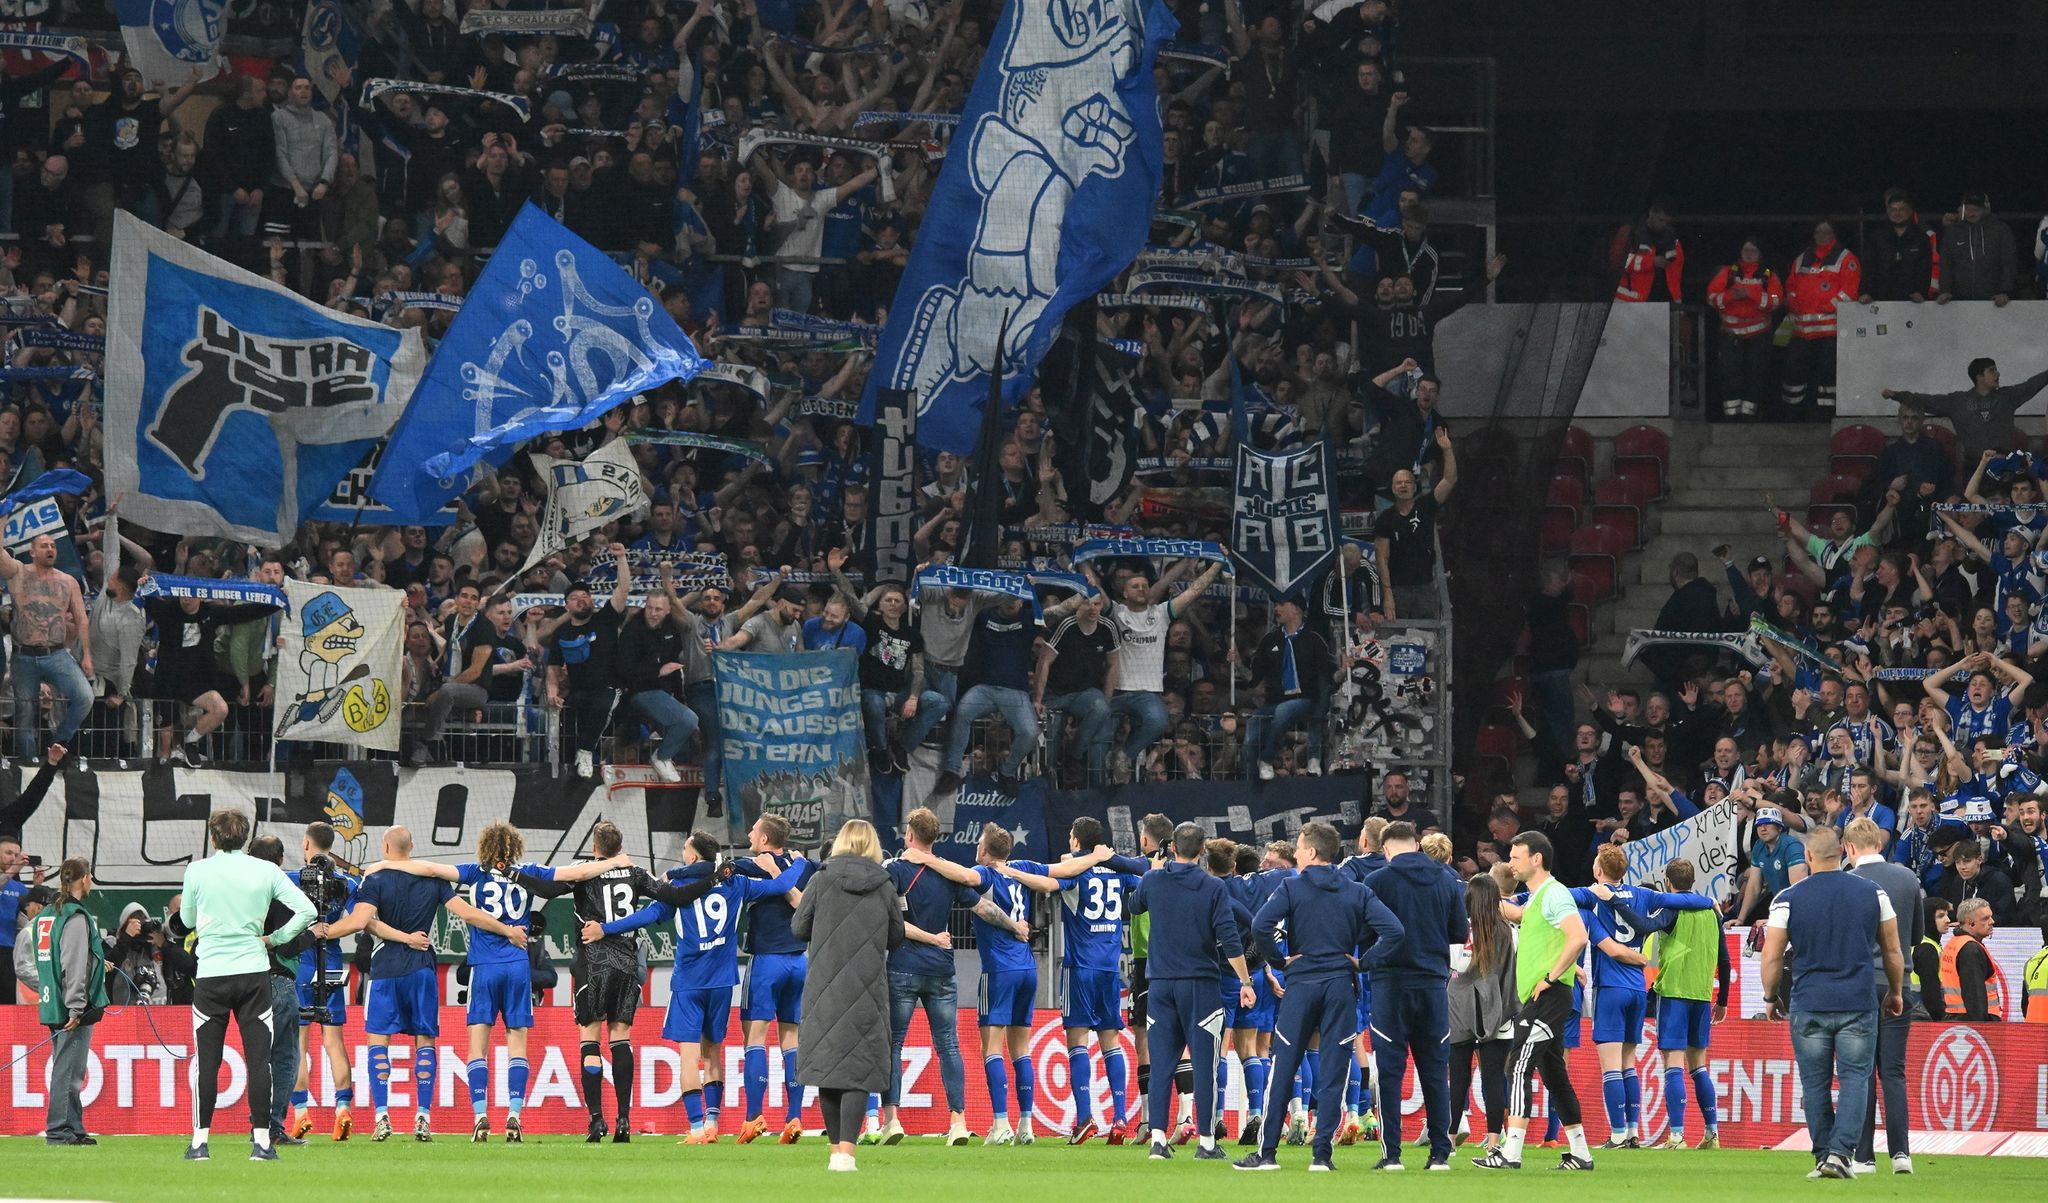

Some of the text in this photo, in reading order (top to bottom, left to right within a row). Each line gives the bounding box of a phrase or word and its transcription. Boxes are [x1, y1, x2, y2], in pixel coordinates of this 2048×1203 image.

[203, 310, 371, 378] ULTRA
[1290, 455, 1320, 488] C
[1242, 494, 1317, 518] HUGOS
[1292, 516, 1327, 552] B
[170, 586, 193, 599] WEIL
[196, 587, 208, 599] ES
[212, 589, 242, 601] UNSER
[246, 591, 273, 605] LEBEN
[935, 567, 1025, 594] HUGOS
[723, 738, 833, 764] STEHN
[481, 880, 528, 921] 30
[602, 882, 635, 923] 13
[693, 892, 728, 939] 19
[1083, 877, 1123, 921] 35
